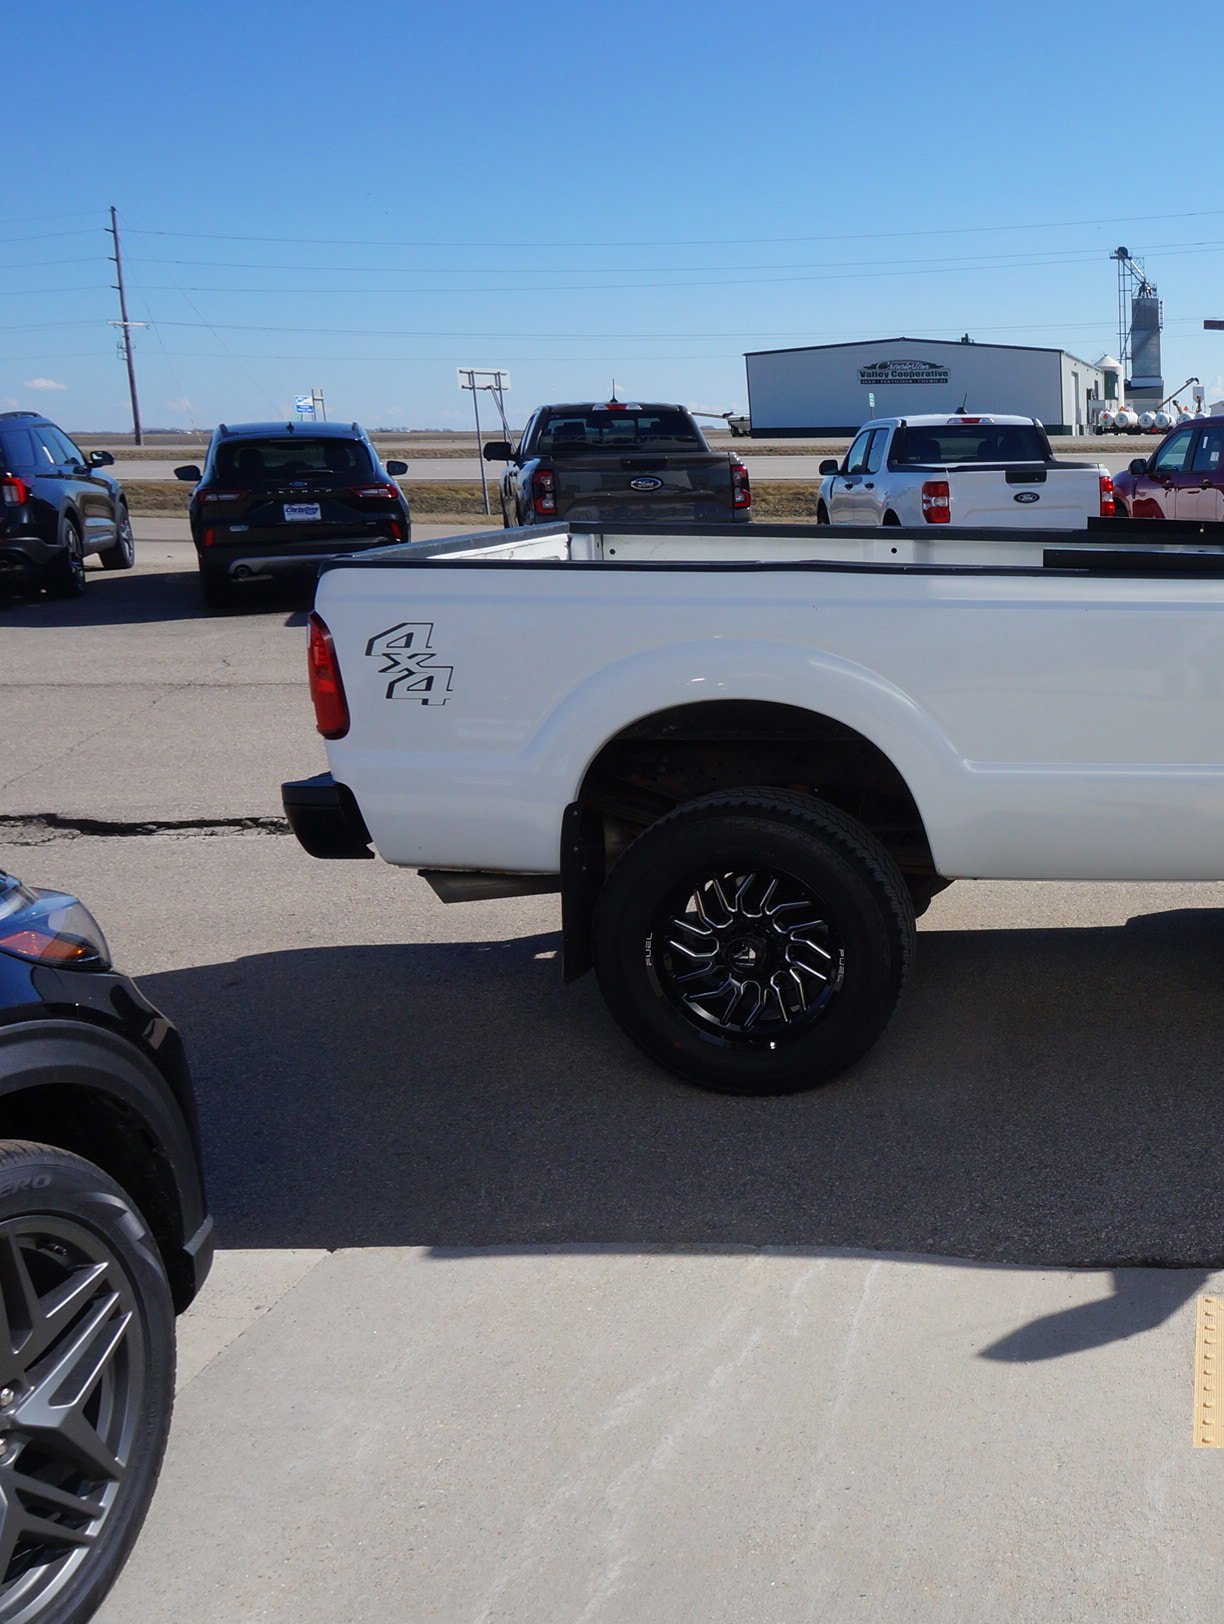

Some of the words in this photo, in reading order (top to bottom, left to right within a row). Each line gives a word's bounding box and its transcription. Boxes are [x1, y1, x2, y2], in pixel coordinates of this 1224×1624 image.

[860, 370, 889, 378] Valley
[891, 370, 949, 378] Cooperative
[645, 932, 653, 966] FUEL
